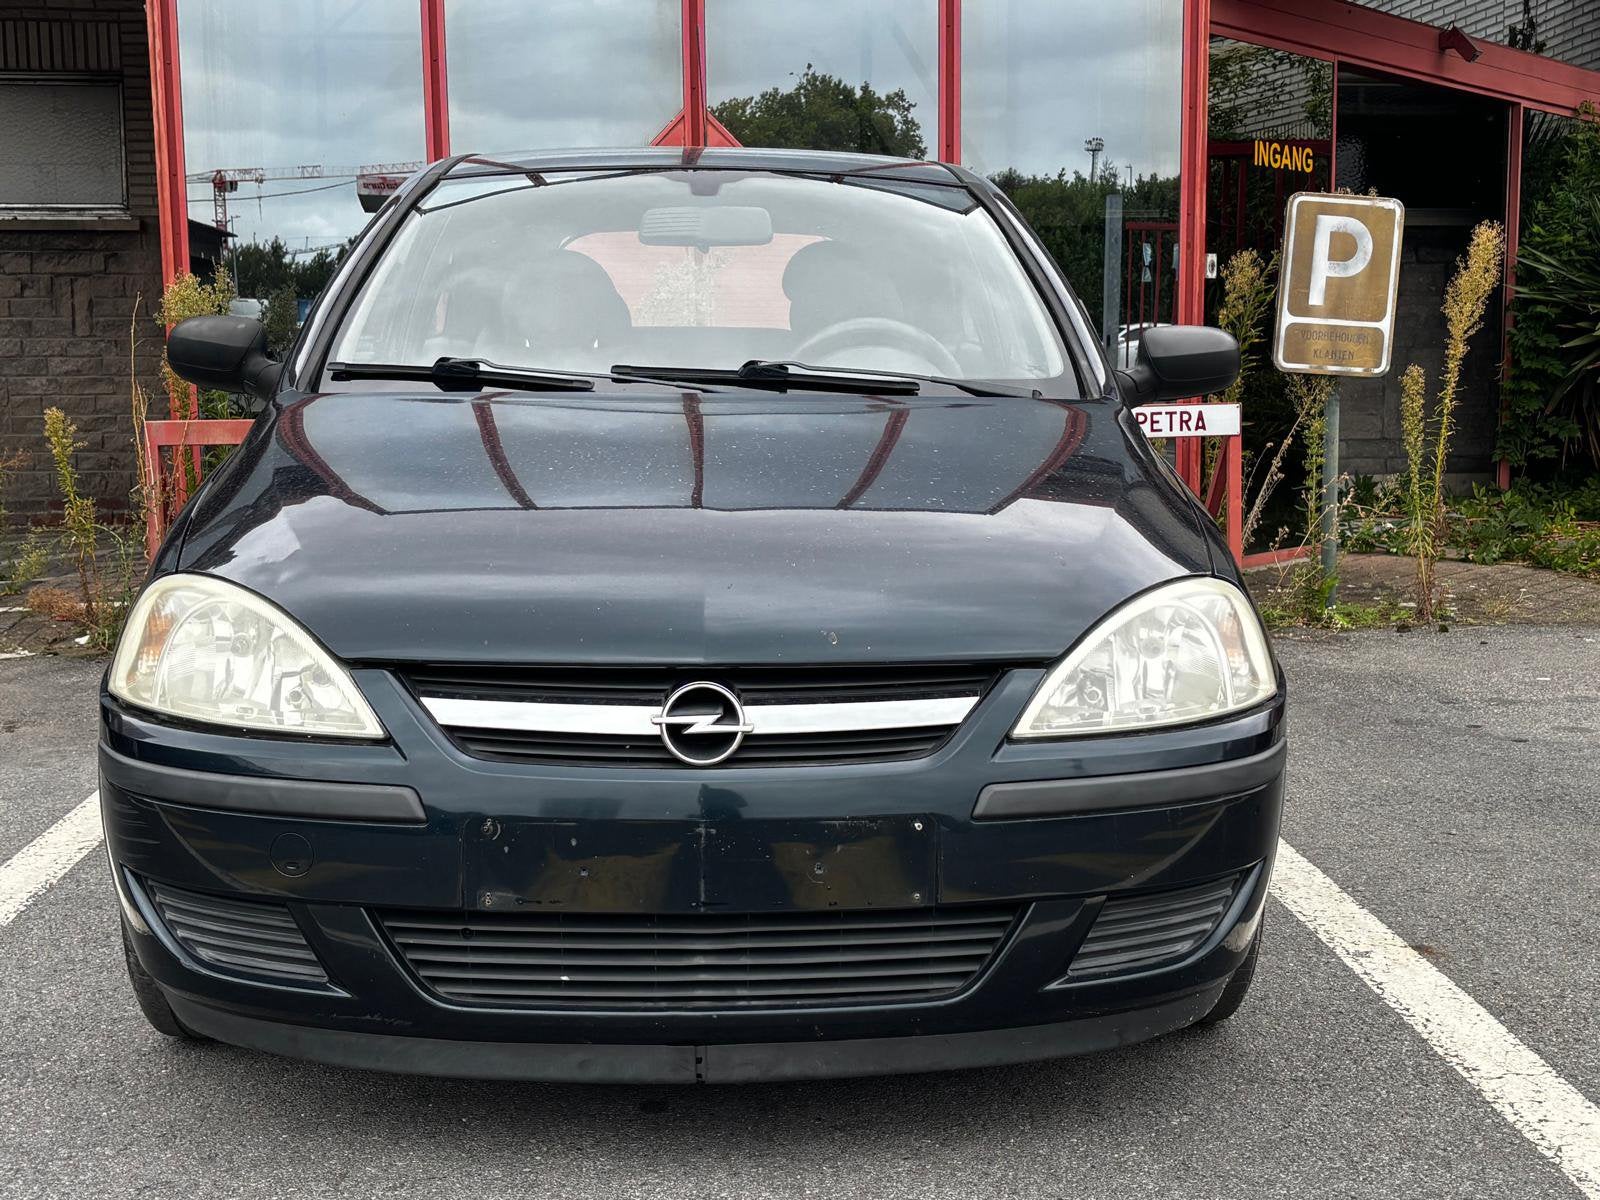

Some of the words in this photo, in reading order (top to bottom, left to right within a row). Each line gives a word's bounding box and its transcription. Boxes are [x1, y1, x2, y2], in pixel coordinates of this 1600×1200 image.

[1254, 140, 1313, 173] INGANG
[1309, 214, 1373, 306] P
[1135, 410, 1207, 433] PETRA
